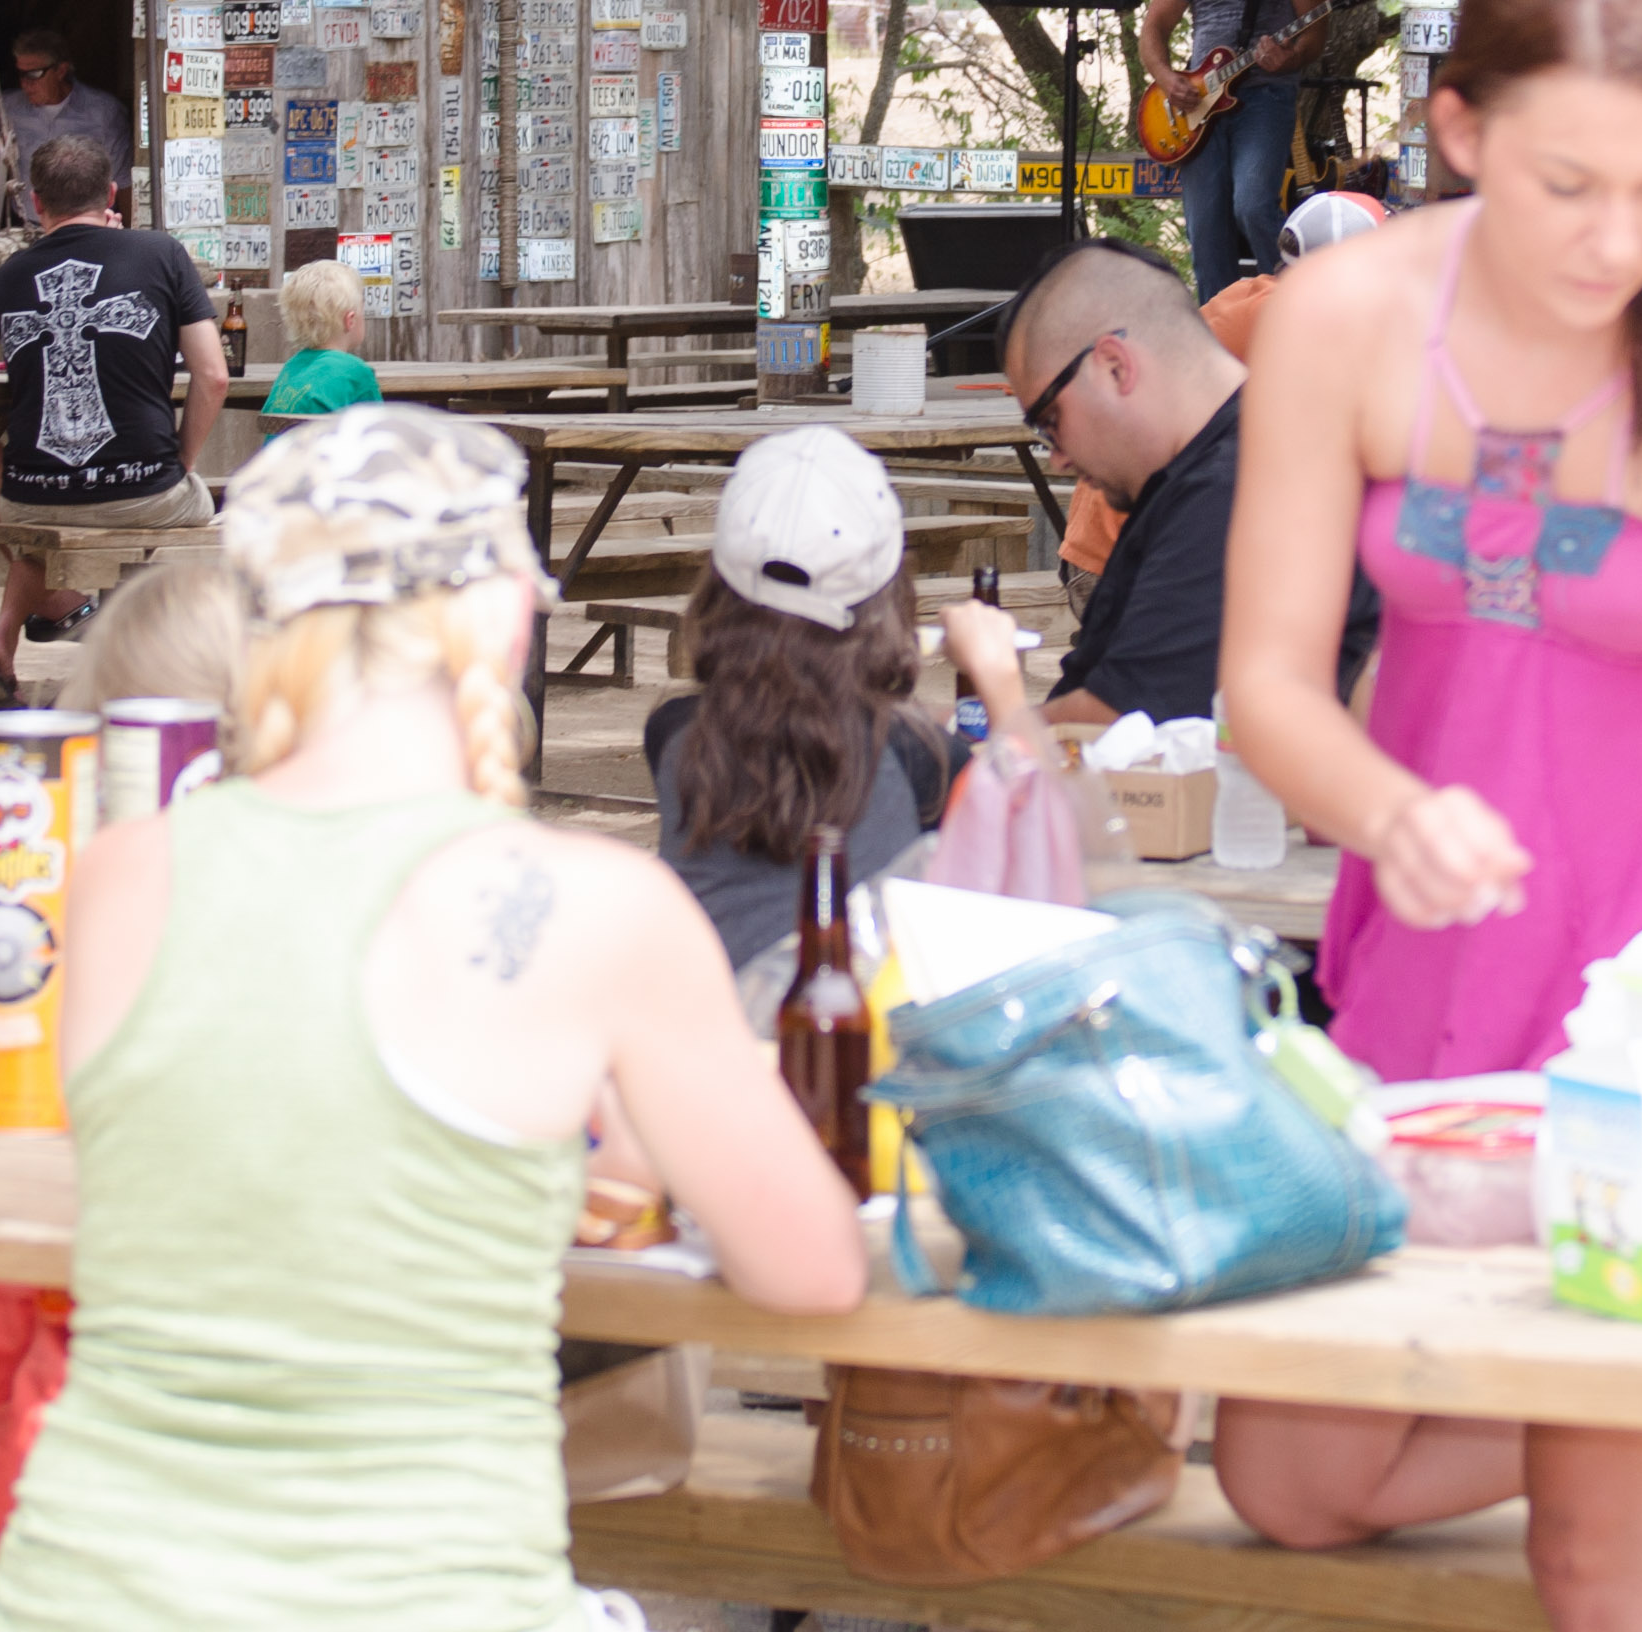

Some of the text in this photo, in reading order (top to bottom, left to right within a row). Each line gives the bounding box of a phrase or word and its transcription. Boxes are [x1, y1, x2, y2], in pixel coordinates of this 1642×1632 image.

[655, 14, 674, 23] TEXAS
[185, 54, 208, 65] TEXAS
[185, 67, 219, 90] CUTEM
[593, 86, 636, 106] TEES MOM
[184, 108, 218, 129] AGGIE
[974, 153, 998, 162] TEXAS
[1086, 168, 1129, 189] LUT
[770, 181, 815, 207] PICK
